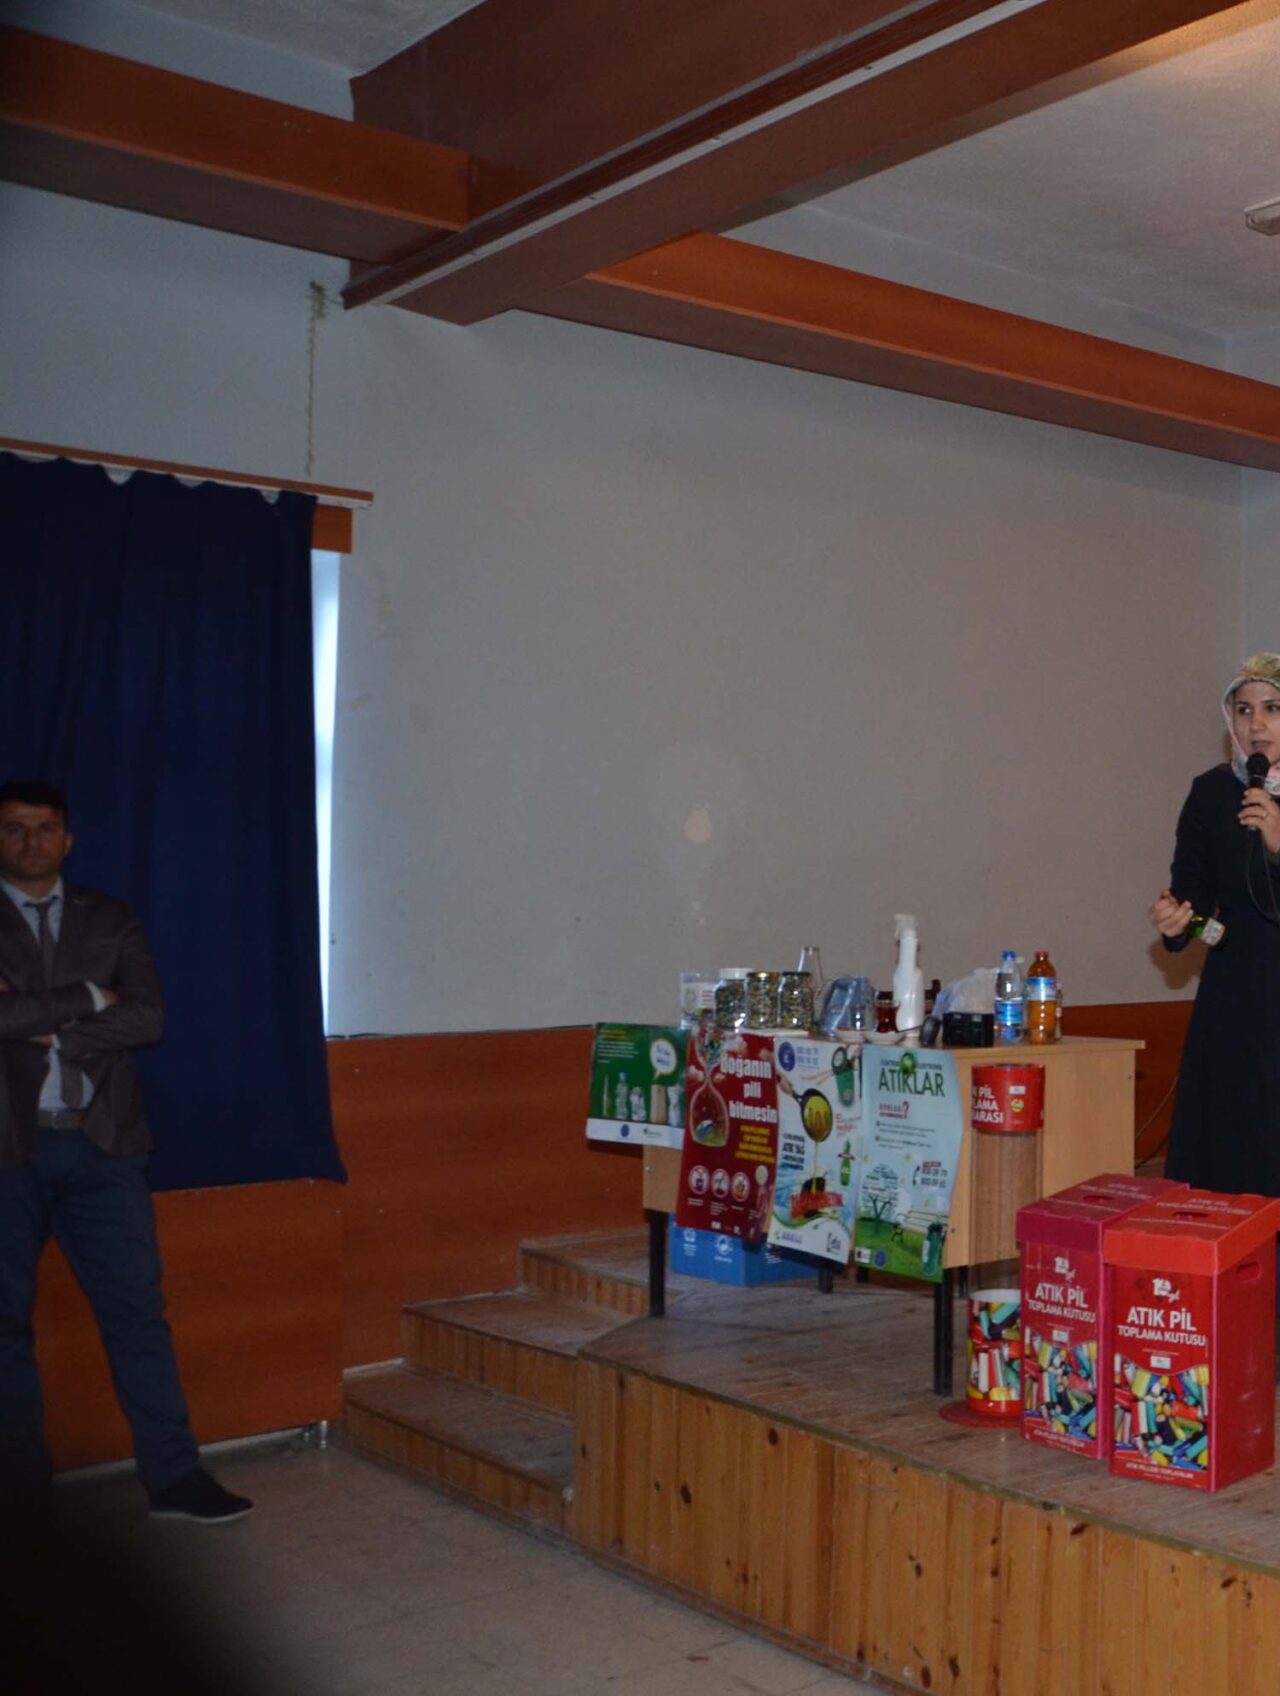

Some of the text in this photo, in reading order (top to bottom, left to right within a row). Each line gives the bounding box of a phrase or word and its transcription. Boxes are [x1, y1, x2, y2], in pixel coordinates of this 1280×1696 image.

[878, 1067, 946, 1097] ATIKLAR
[1035, 1282, 1089, 1309] ATIK PİL
[1027, 1299, 1096, 1323] TOPLAMA KUTUSU
[1126, 1306, 1197, 1331] ATIK PİL
[1118, 1325, 1206, 1346] TOPLAMA KUTUSU
